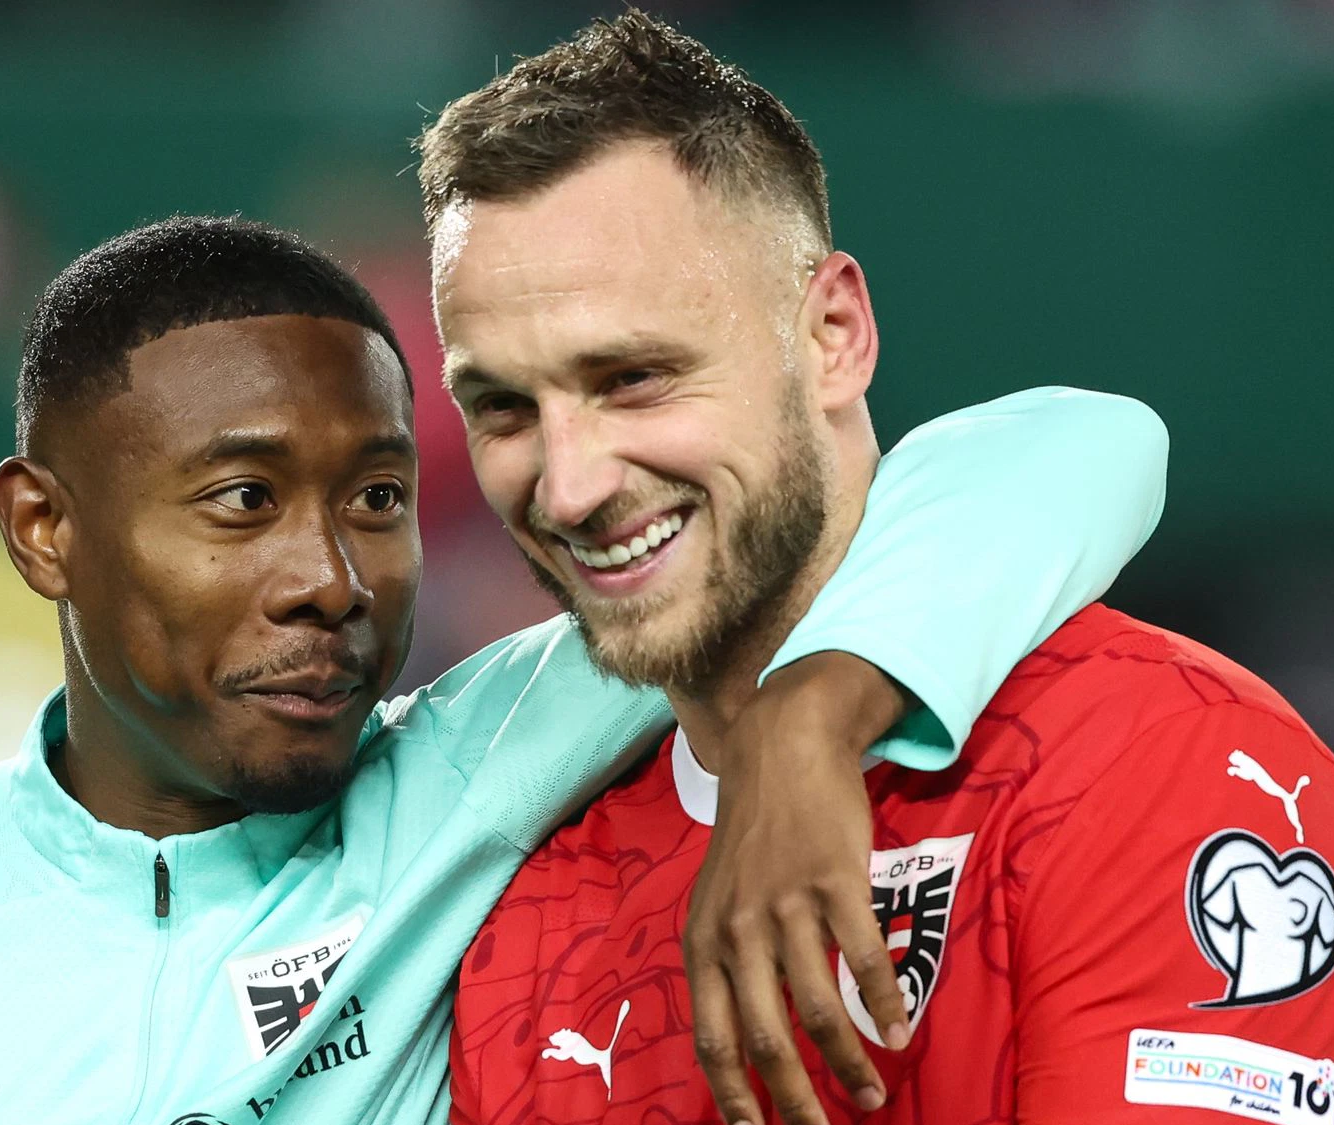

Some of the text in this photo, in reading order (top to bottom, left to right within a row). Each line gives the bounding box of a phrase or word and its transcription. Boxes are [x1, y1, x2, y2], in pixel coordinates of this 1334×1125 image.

[889, 855, 934, 878] ÖFB
[248, 936, 352, 981] SEIT ÖFB 1904
[1137, 1036, 1175, 1050] UEFA
[1134, 1058, 1283, 1095] FOUNDATION
[1288, 1071, 1331, 1116] 10
